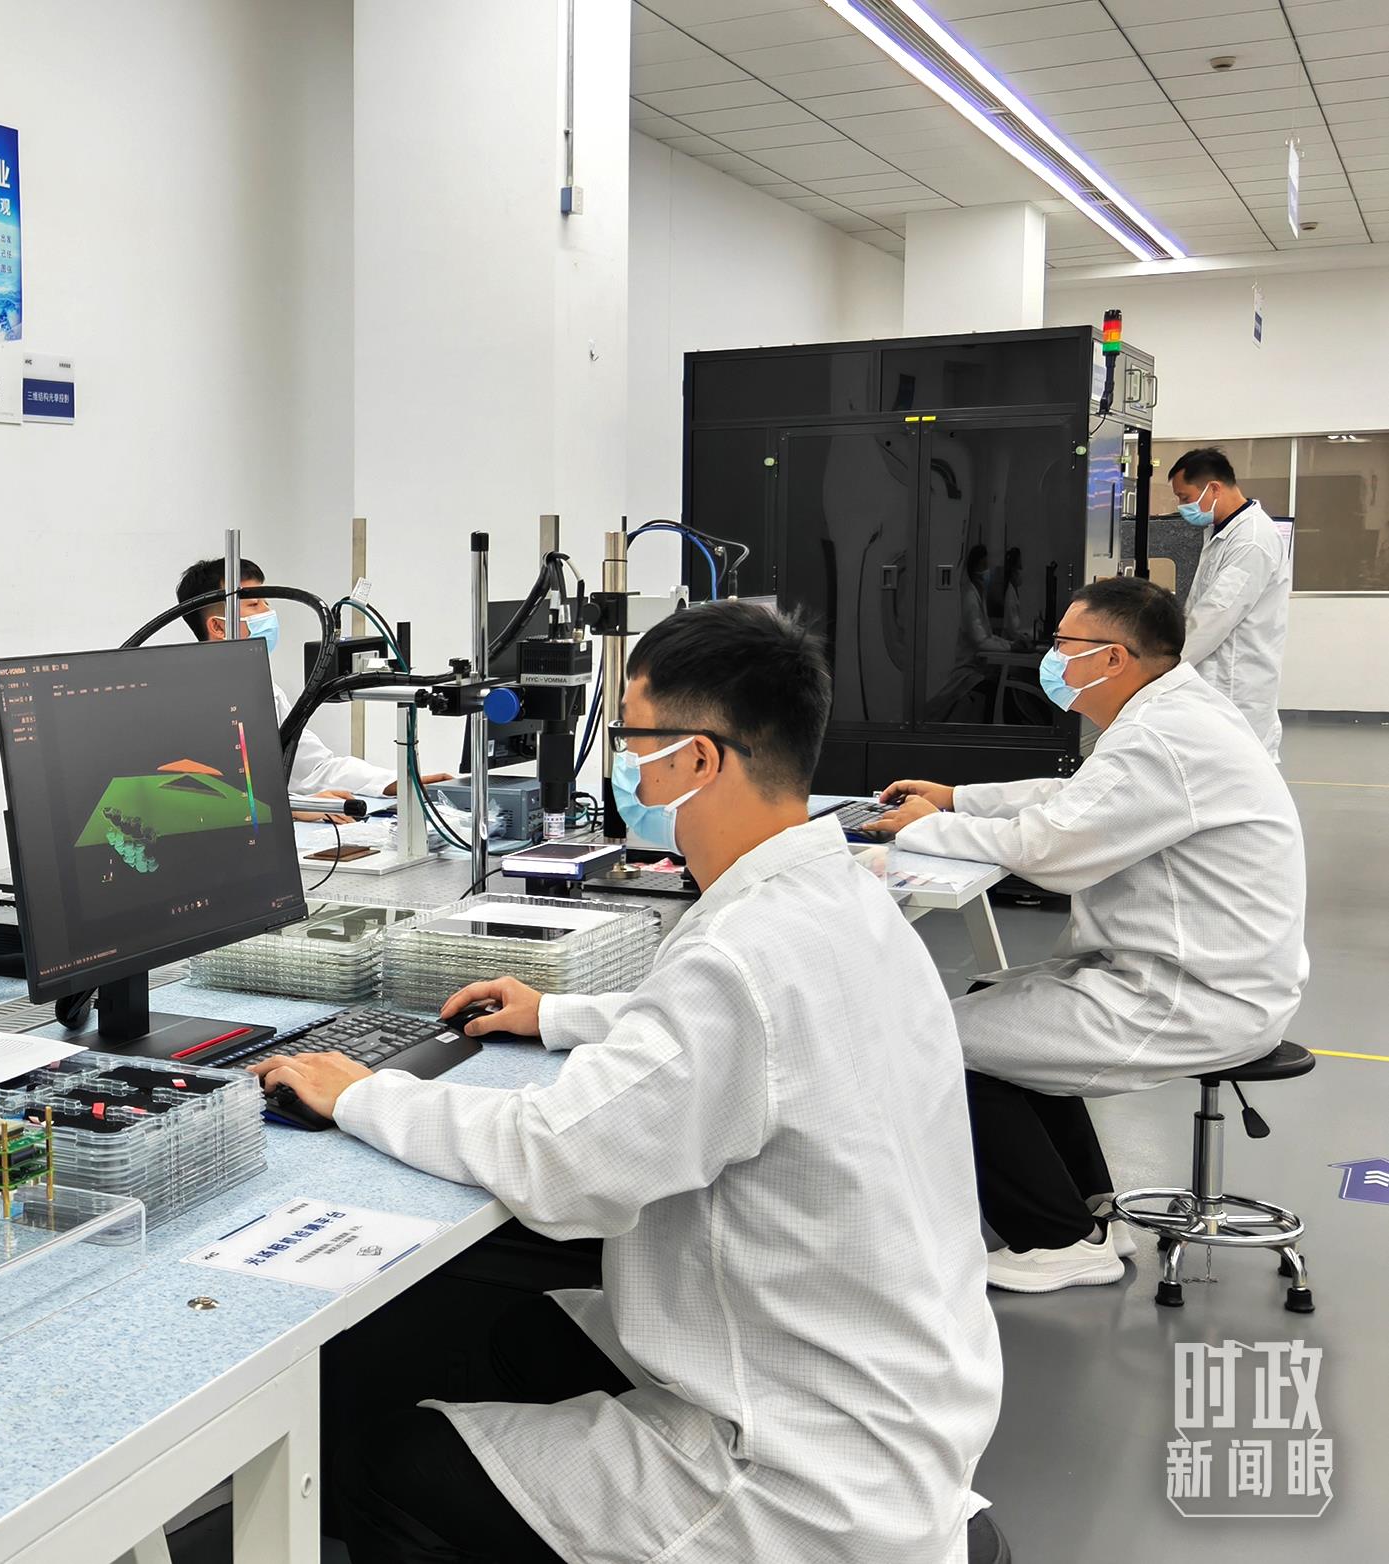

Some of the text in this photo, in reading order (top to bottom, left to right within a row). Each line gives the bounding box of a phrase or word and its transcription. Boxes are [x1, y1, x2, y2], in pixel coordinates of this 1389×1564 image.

[243, 1210, 347, 1267] 光场相机检测平台
